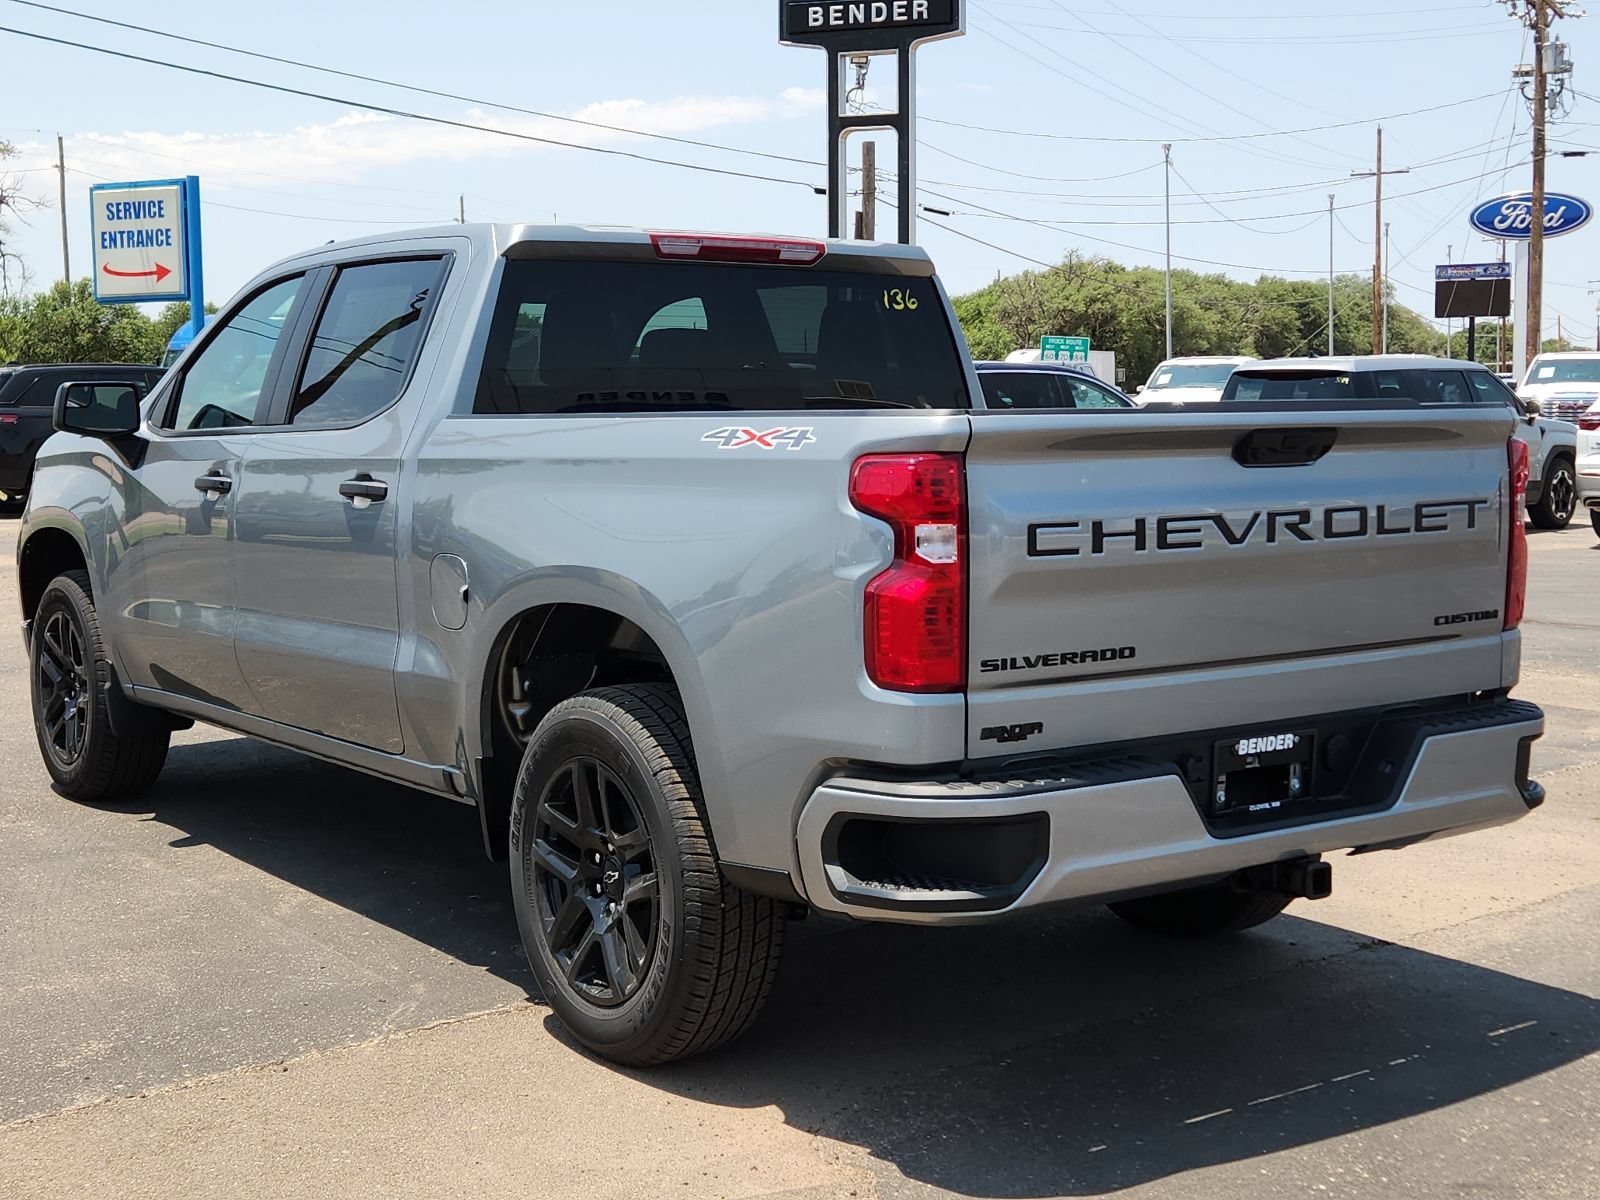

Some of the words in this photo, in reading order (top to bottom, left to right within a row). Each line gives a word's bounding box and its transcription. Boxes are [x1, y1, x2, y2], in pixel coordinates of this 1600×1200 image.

[808, 0, 929, 27] BENDER
[105, 200, 165, 221] SERVICE
[1494, 200, 1566, 230] Fod
[100, 228, 172, 249] ENTRANCE
[883, 288, 918, 310] 136
[1027, 499, 1489, 557] CHEVROLET
[1434, 609, 1499, 626] CUSTOM
[980, 646, 1136, 673] SILVERADO
[1238, 733, 1294, 755] BENDER
